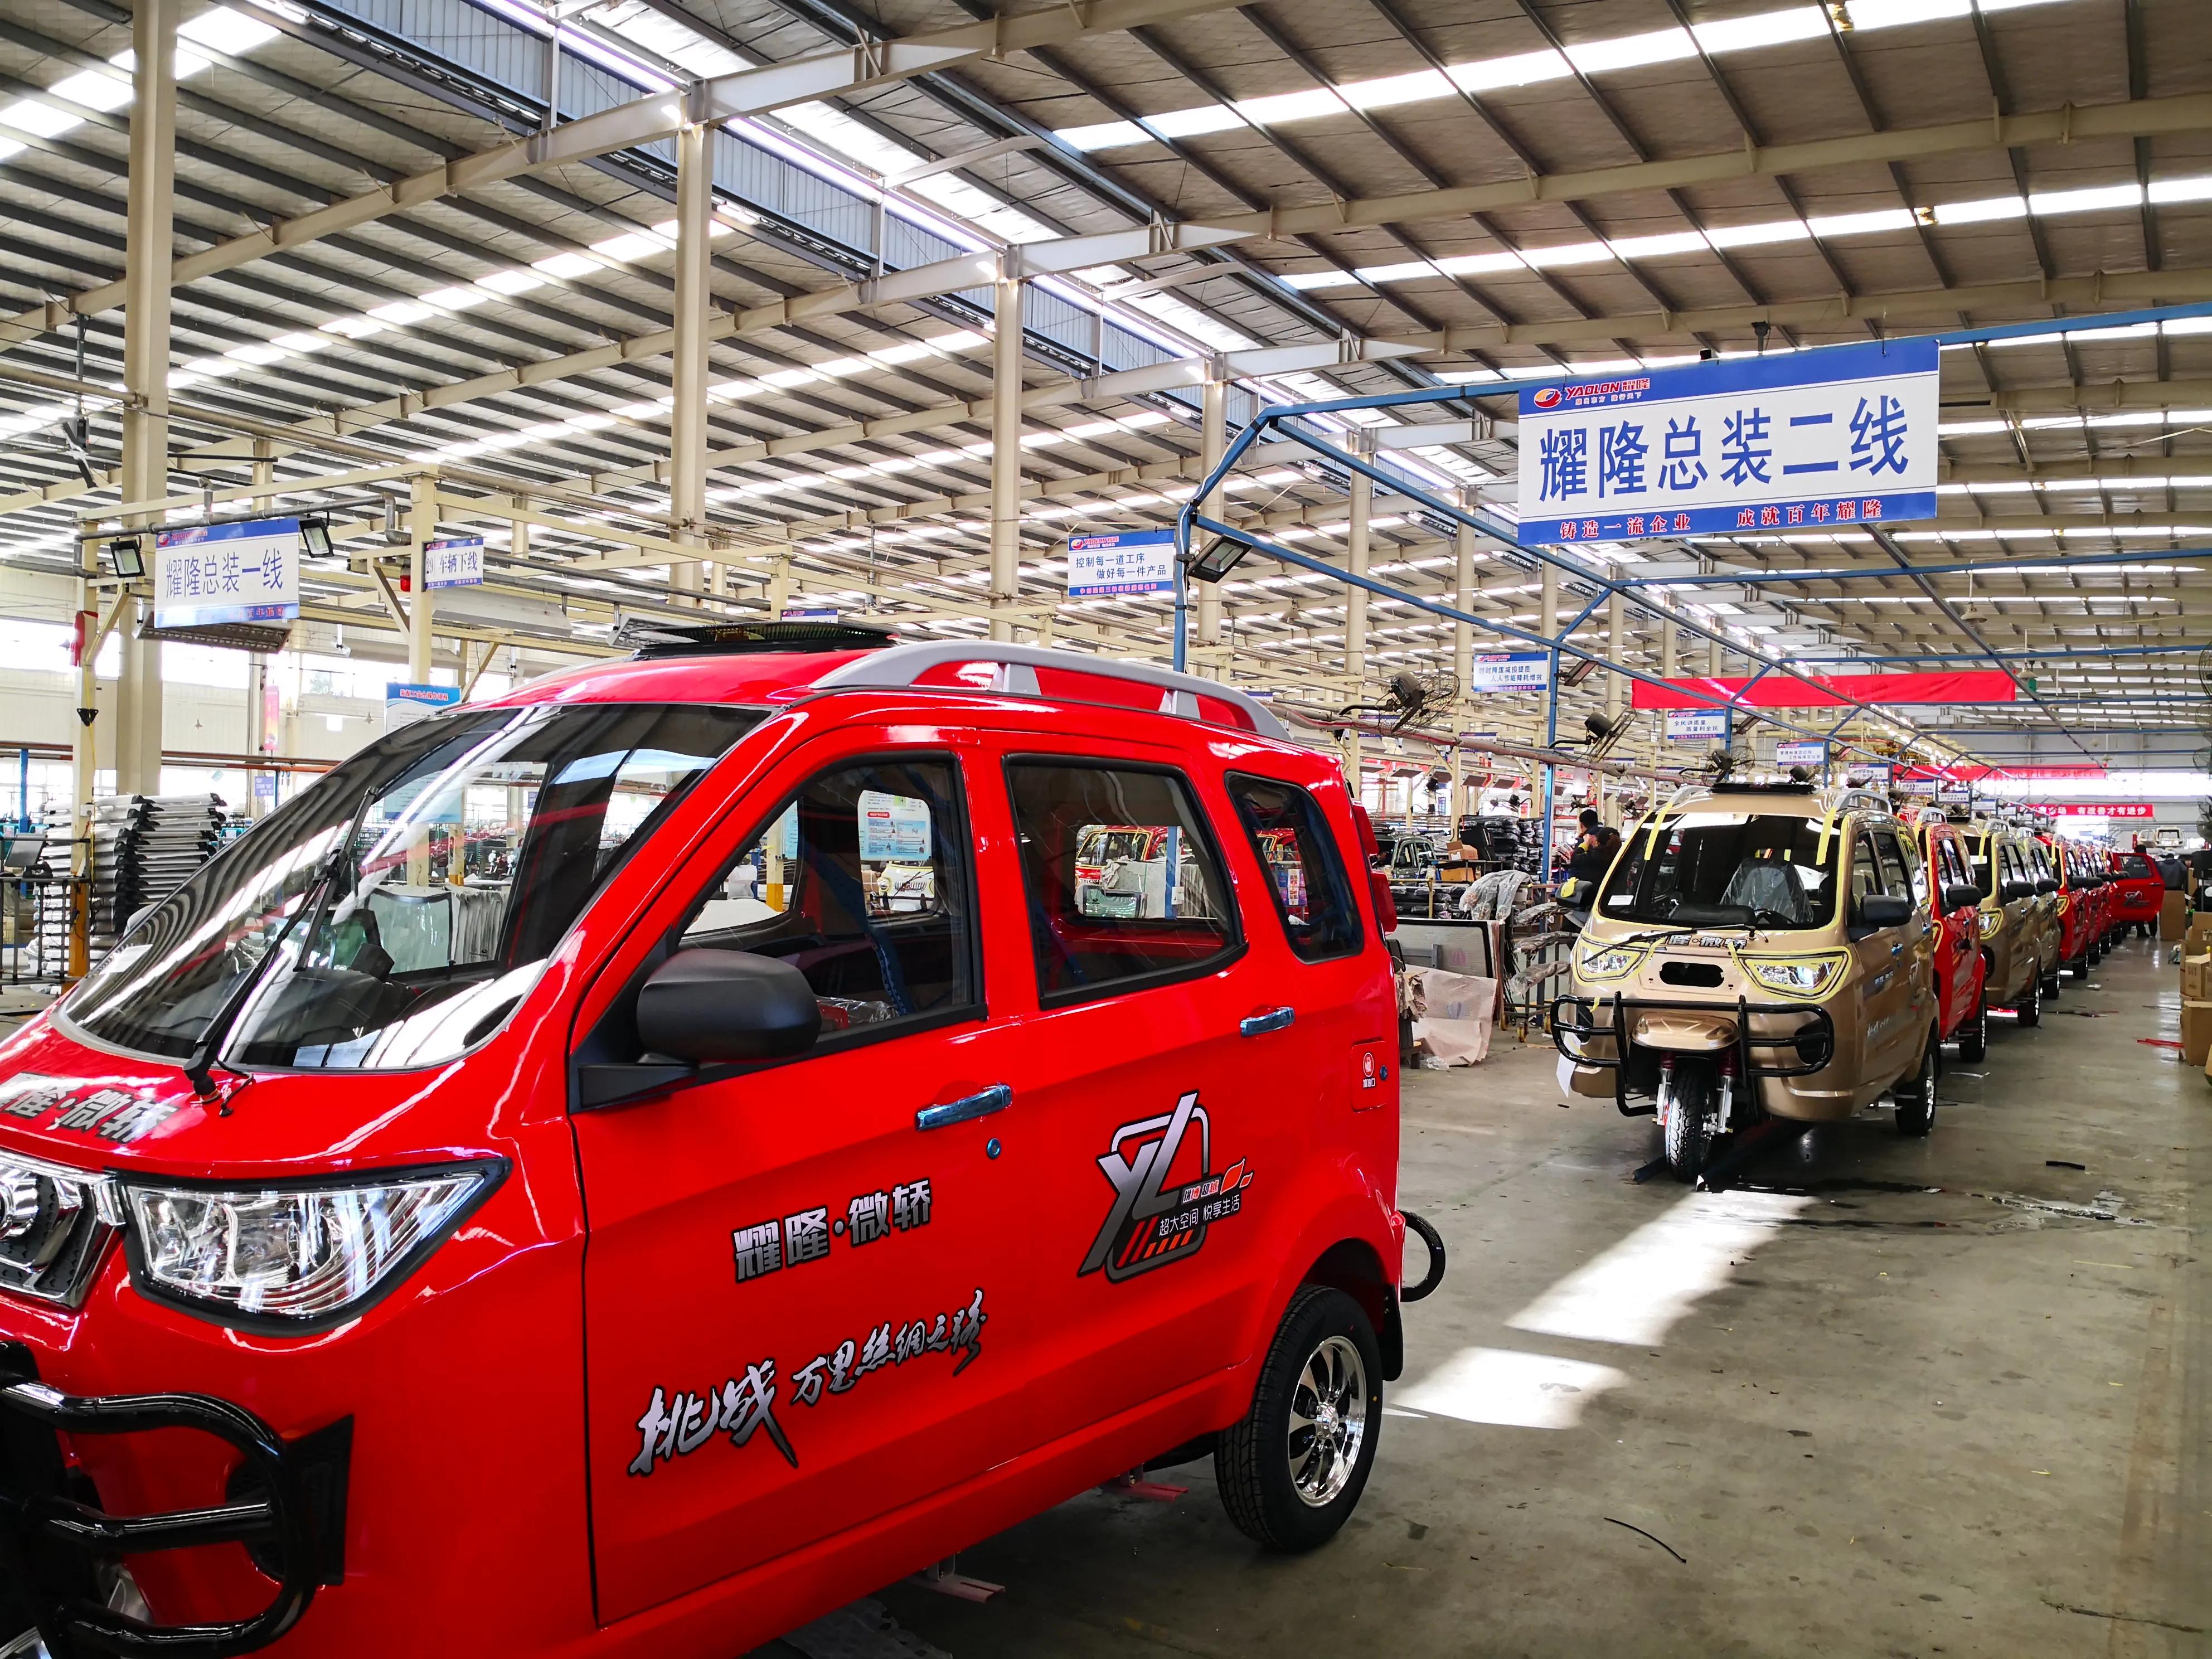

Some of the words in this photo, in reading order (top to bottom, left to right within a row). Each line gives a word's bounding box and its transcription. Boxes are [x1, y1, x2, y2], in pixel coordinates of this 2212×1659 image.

[1565, 381, 1621, 400] YAOLON
[1539, 394, 1909, 502] 耀隆总装二线
[1559, 513, 1691, 540] 铸造一流企业
[1736, 499, 1883, 528] 成就百年耀隆
[166, 548, 283, 598] 耀隆总装一线
[1076, 552, 1145, 568] 控制每一道工序
[1096, 565, 1166, 580] 做好每一件产品
[1159, 1207, 1199, 1237] 超大空间
[1203, 1194, 1240, 1221] 悦享生活
